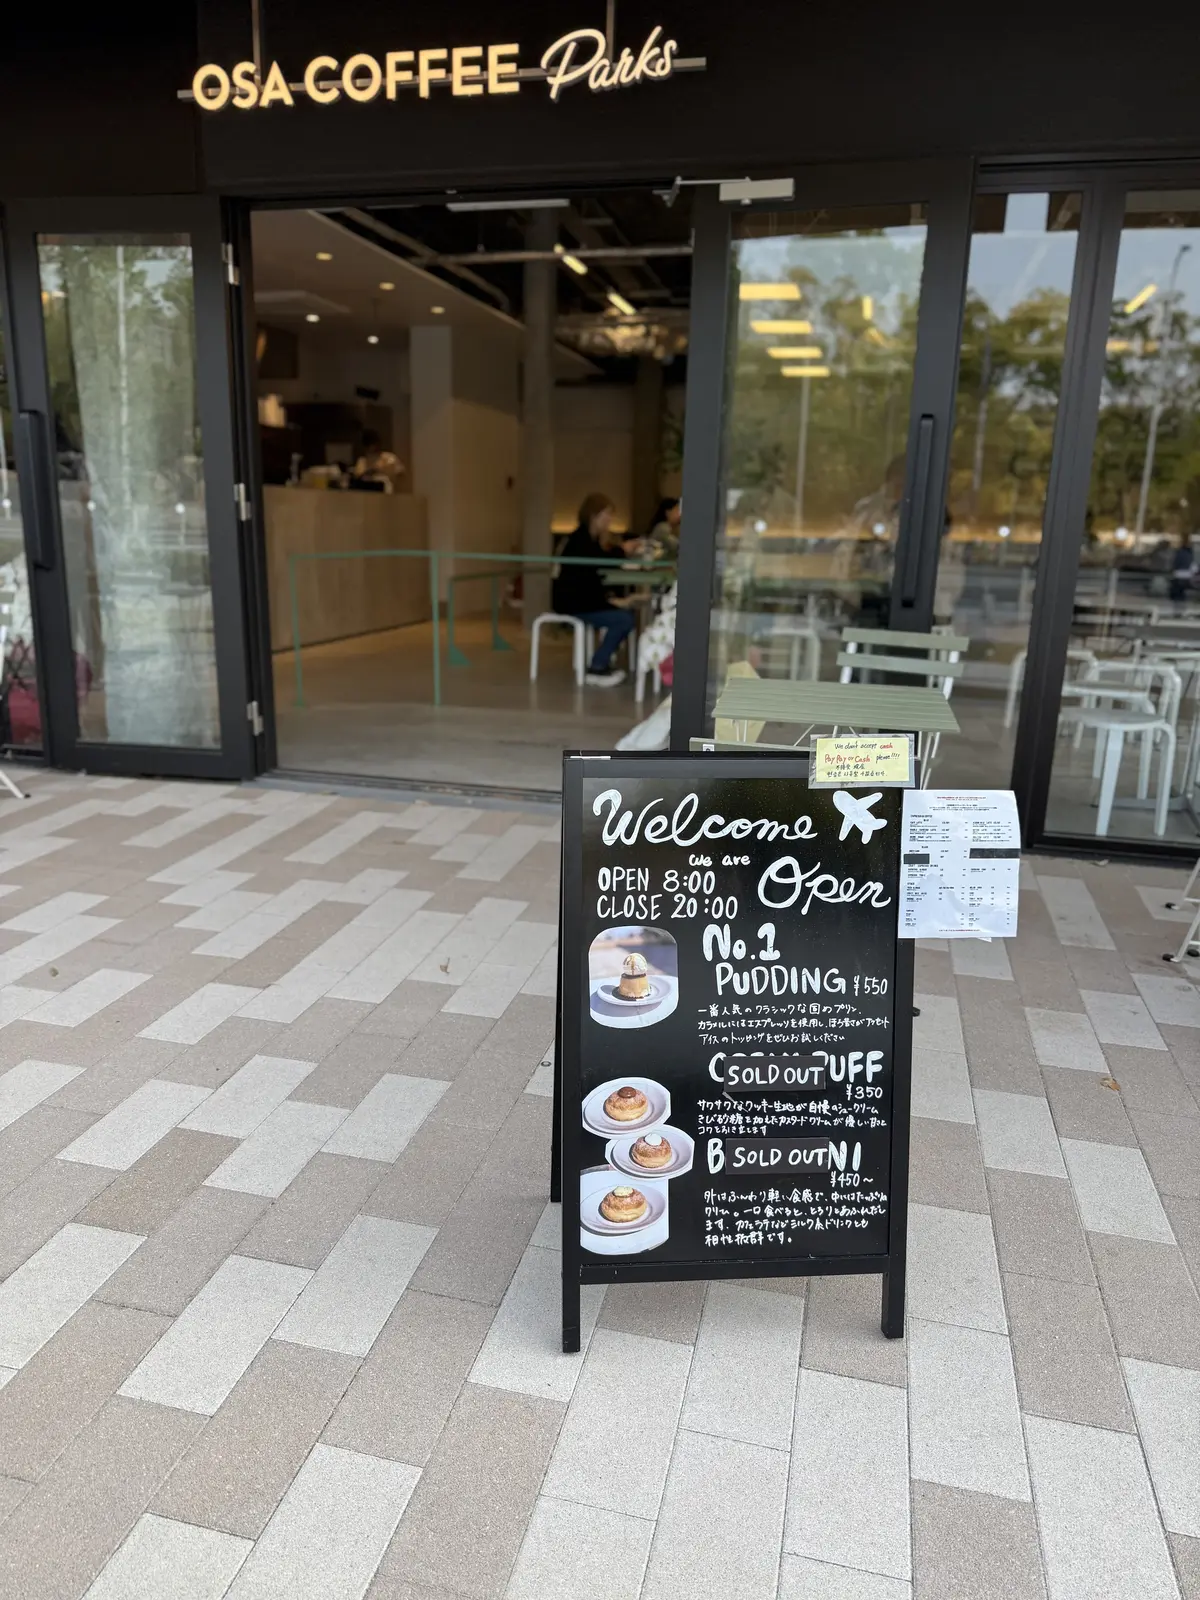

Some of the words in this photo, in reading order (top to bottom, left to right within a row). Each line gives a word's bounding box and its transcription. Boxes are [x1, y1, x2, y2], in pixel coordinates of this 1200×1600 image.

[192, 61, 294, 111] OSA
[304, 43, 520, 103] COFFEE
[540, 26, 679, 100] Parks
[854, 754, 871, 763] Cash
[880, 742, 894, 750] cash
[592, 788, 818, 847] Welcome
[721, 853, 751, 867] are
[597, 866, 650, 892] OPEN
[662, 869, 716, 894] 8:00
[757, 855, 891, 915] Open
[596, 894, 663, 921] CLOSE
[670, 893, 739, 920] 20:00
[702, 922, 781, 962] No.1
[715, 962, 847, 996] PUDDING
[853, 975, 889, 997] ¥550
[727, 1064, 780, 1086] SOLD
[783, 1066, 825, 1086] OUT
[846, 1083, 884, 1101] ¥350
[732, 1146, 783, 1168] SOLD
[788, 1147, 829, 1166] OUT
[704, 1231, 793, 1248] 相性抜群です。
